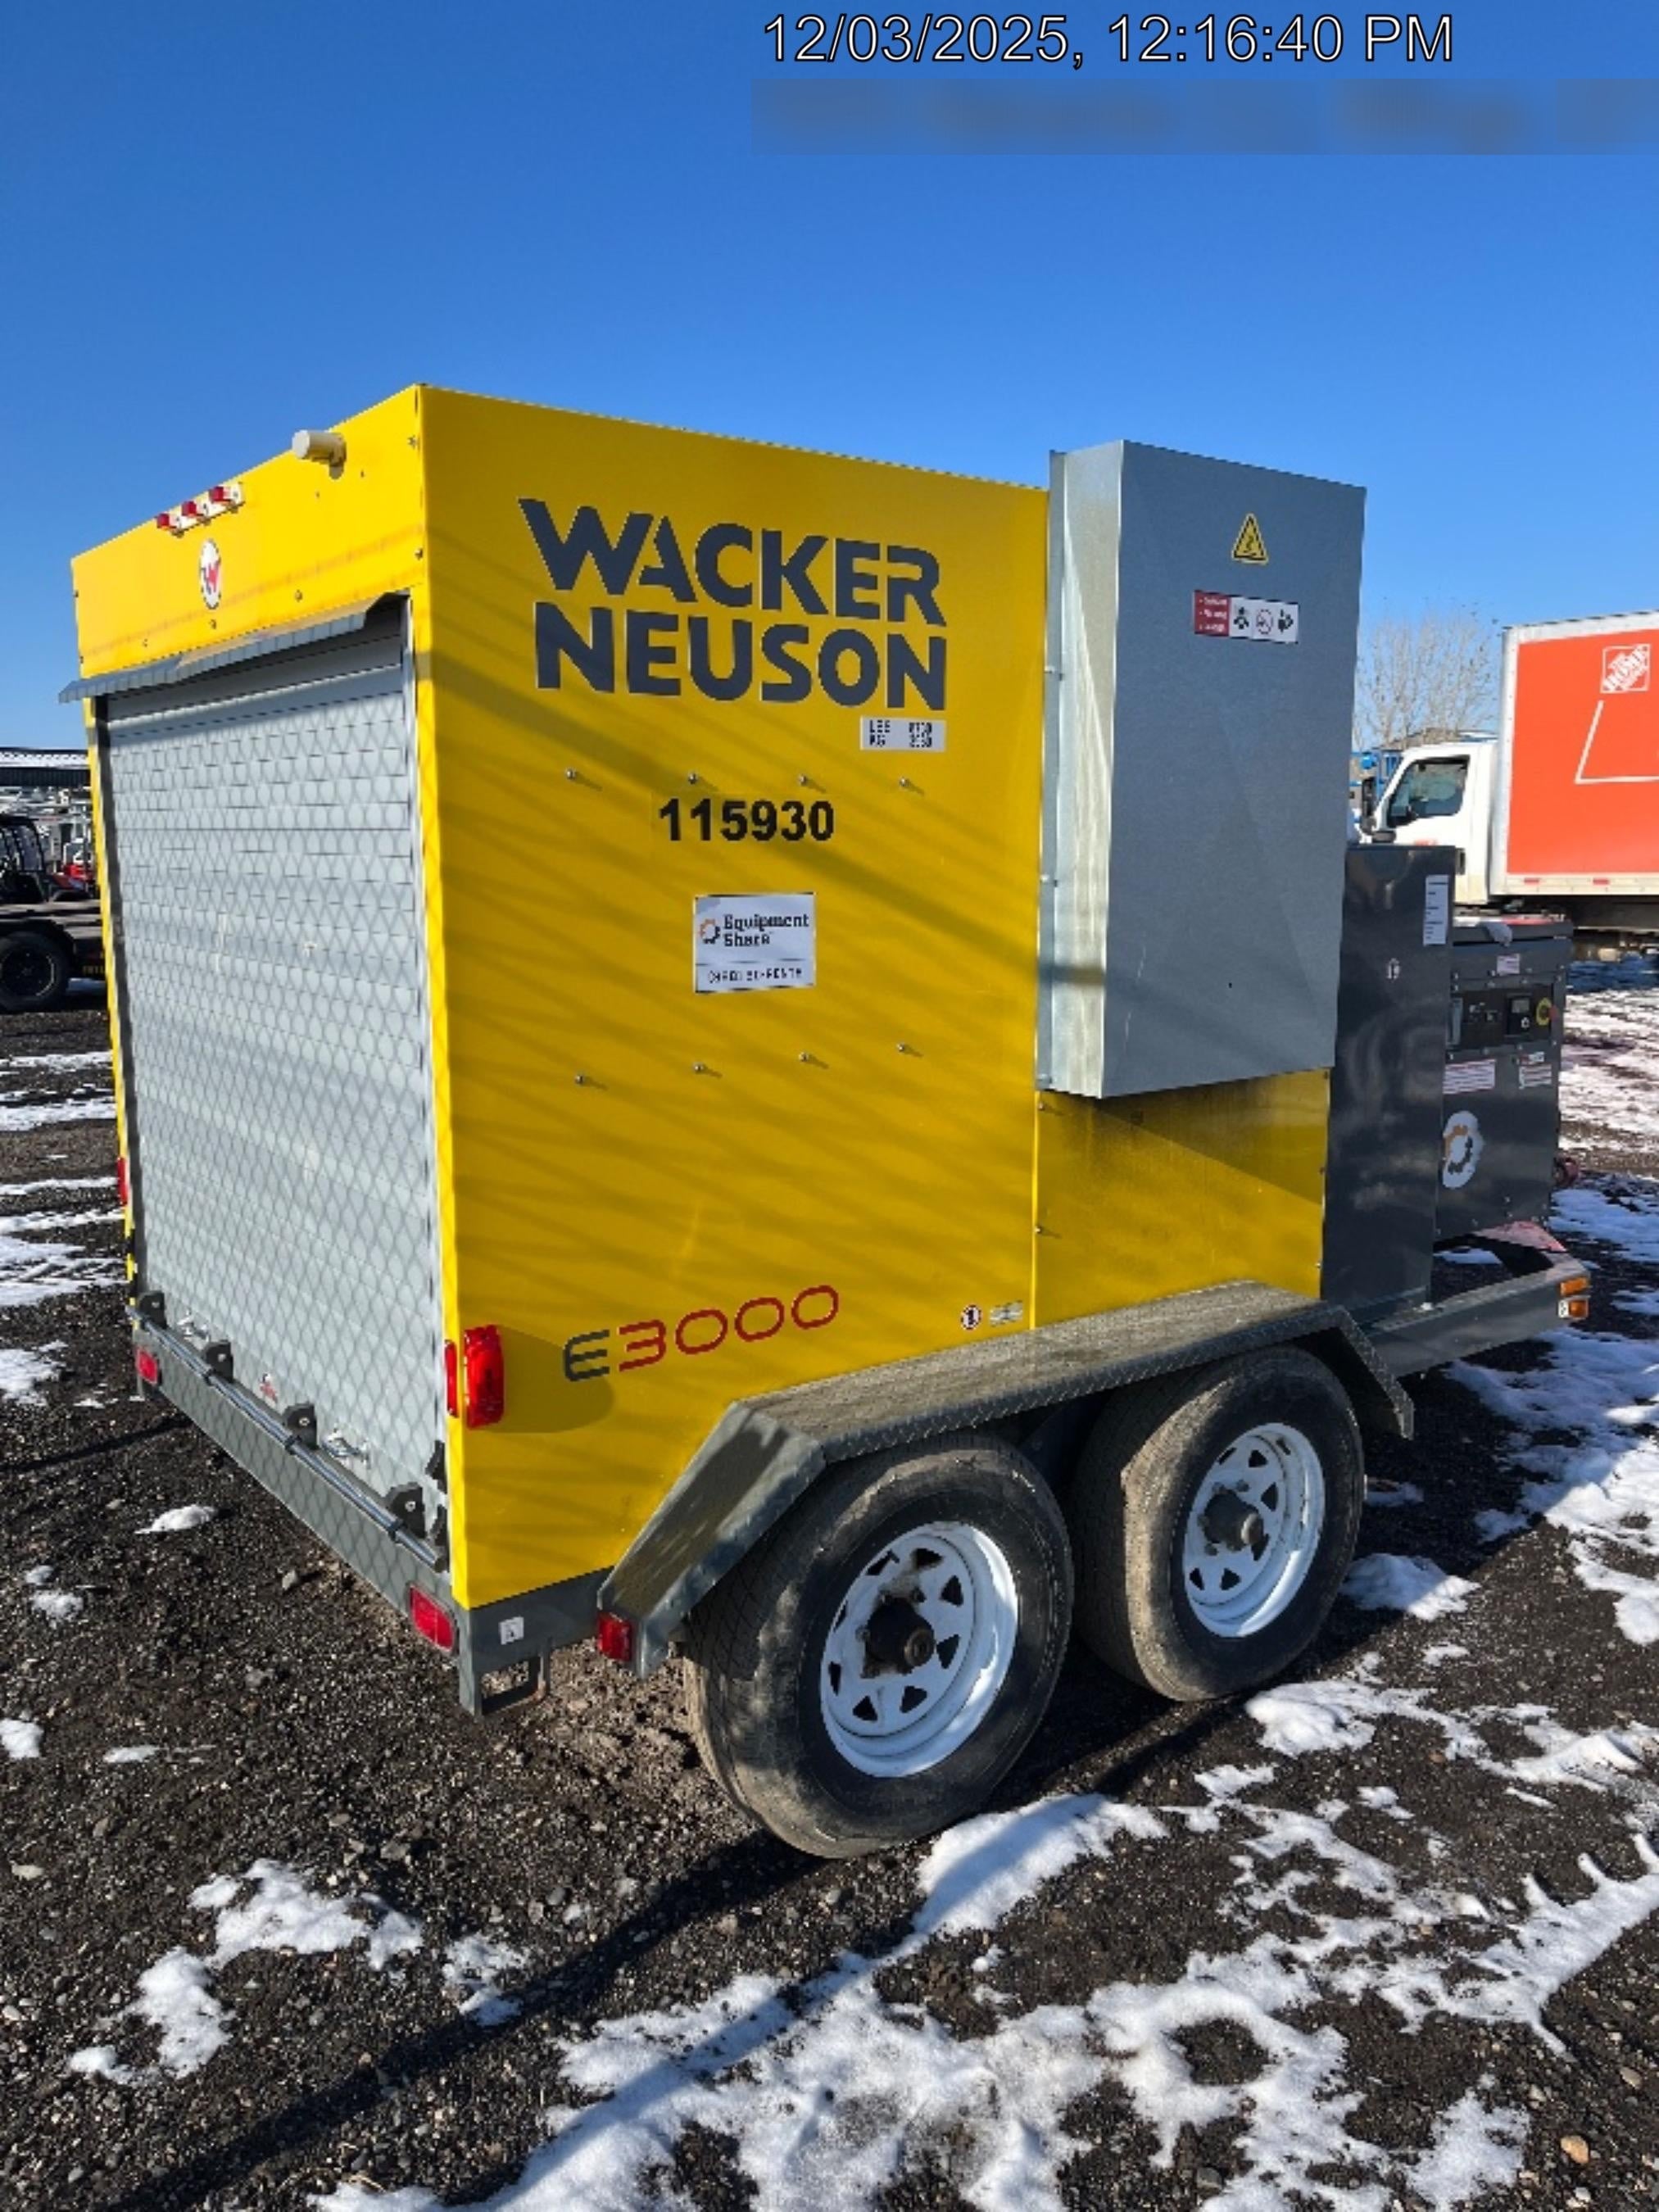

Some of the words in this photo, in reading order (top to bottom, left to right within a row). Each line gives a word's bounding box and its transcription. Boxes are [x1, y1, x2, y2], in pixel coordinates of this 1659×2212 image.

[518, 497, 947, 628] WACKER
[534, 601, 948, 711] NEUSON
[659, 797, 835, 842] 115930
[723, 913, 809, 932] Equipment
[723, 932, 770, 947] Share
[562, 1284, 840, 1383] E3000
